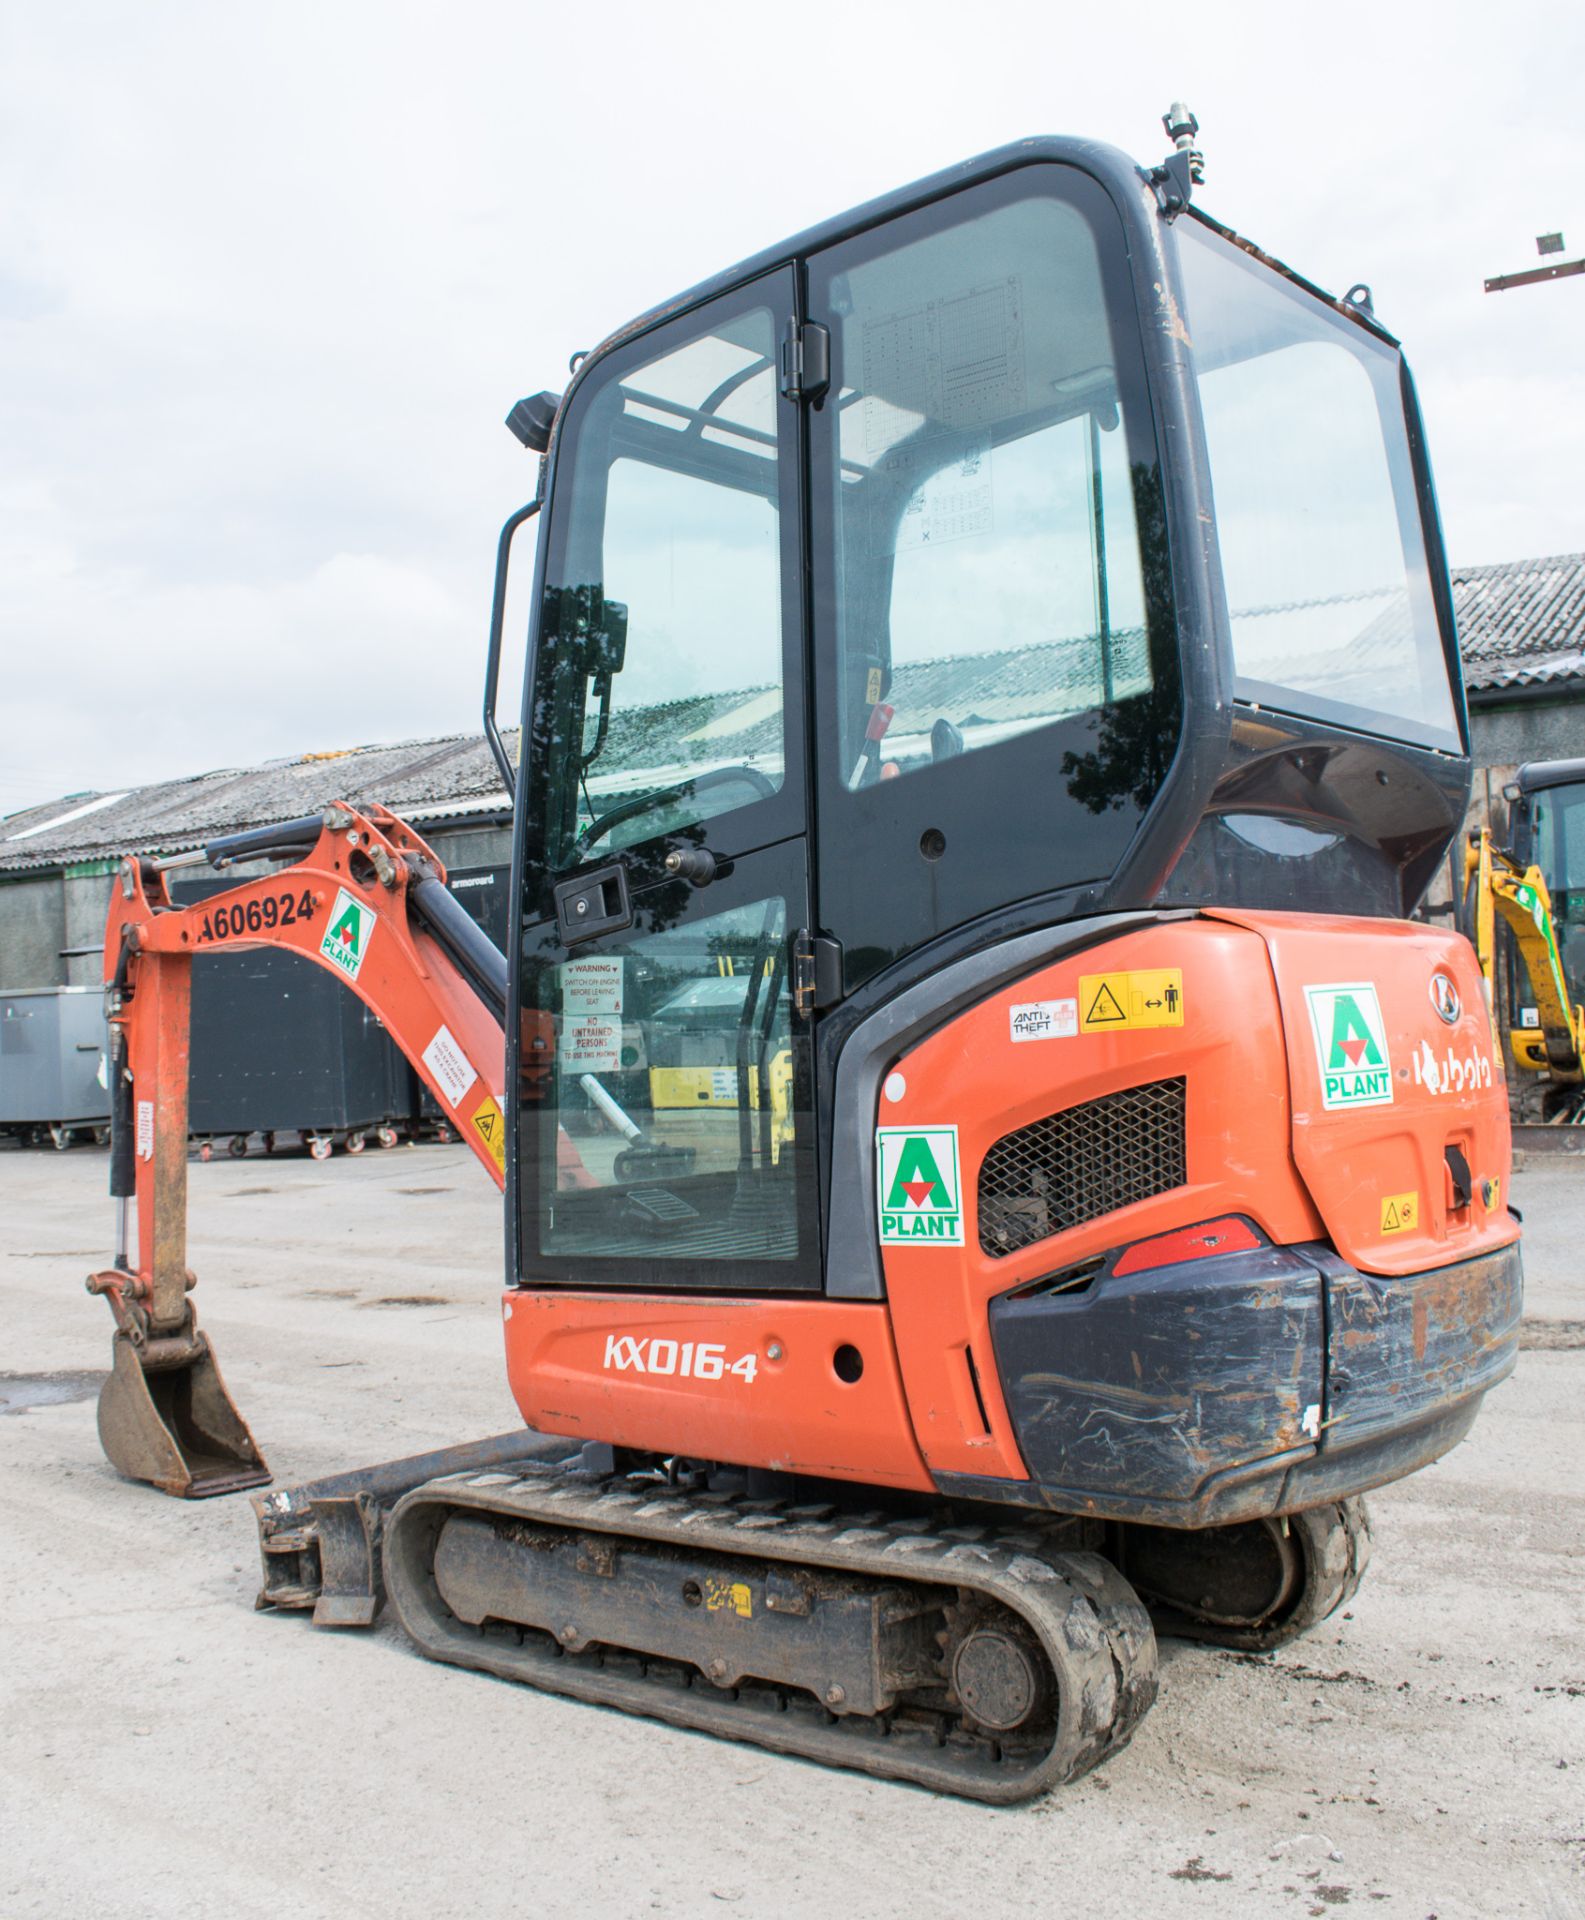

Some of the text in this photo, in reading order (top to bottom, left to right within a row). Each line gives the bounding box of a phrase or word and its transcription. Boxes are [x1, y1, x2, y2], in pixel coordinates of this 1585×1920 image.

[323, 937, 359, 973] PLANT
[575, 965, 611, 973] WARNING
[565, 979, 588, 987] SWITCH
[587, 1016, 598, 1026] NO
[1014, 1011, 1042, 1023] ANTI
[572, 1027, 612, 1038] UNTRAINED
[1013, 1021, 1050, 1033] THEFT
[576, 1038, 608, 1048] PERSONS
[1325, 1072, 1389, 1099] PLANT
[882, 1215, 959, 1236] PLANT
